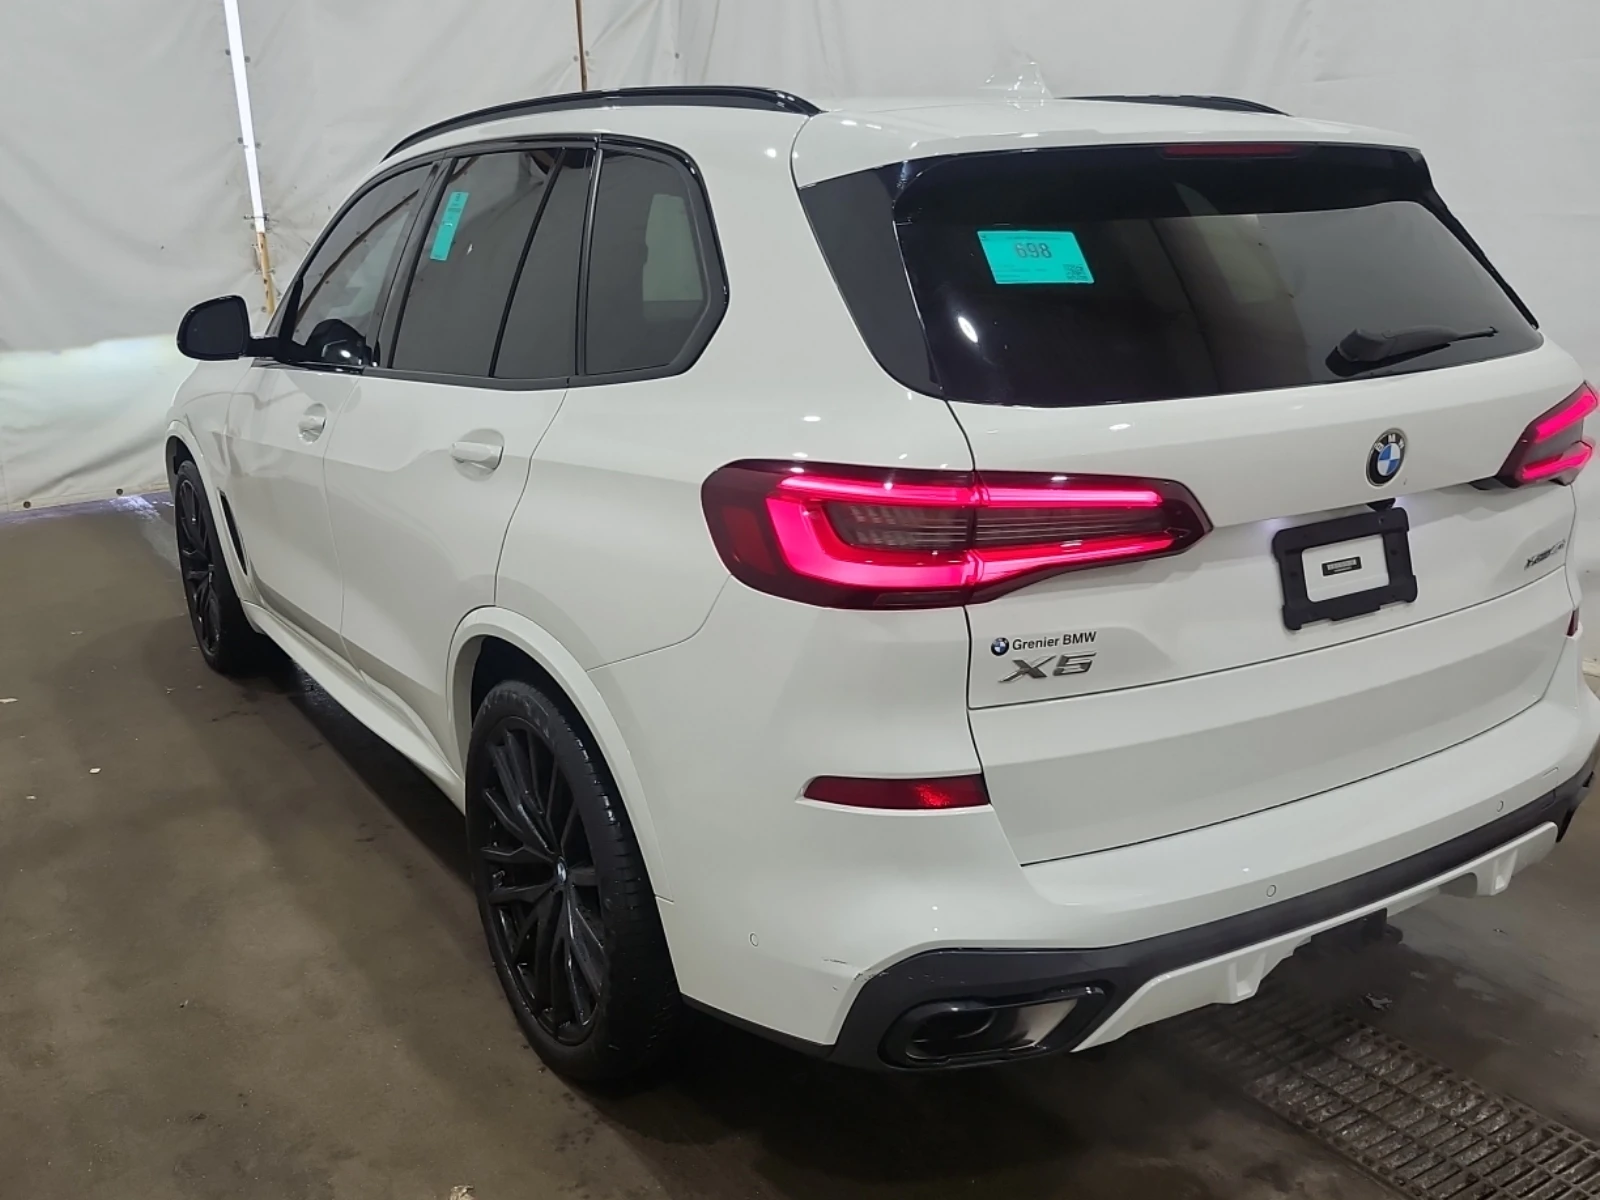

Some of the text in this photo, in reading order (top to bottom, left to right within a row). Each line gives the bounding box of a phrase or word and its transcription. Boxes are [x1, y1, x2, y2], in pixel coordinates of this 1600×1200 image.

[1015, 242, 1052, 259] 698
[1374, 433, 1405, 452] BMW
[1012, 636, 1060, 650] Grenier
[1062, 631, 1097, 645] BMW
[998, 650, 1097, 683] X5
